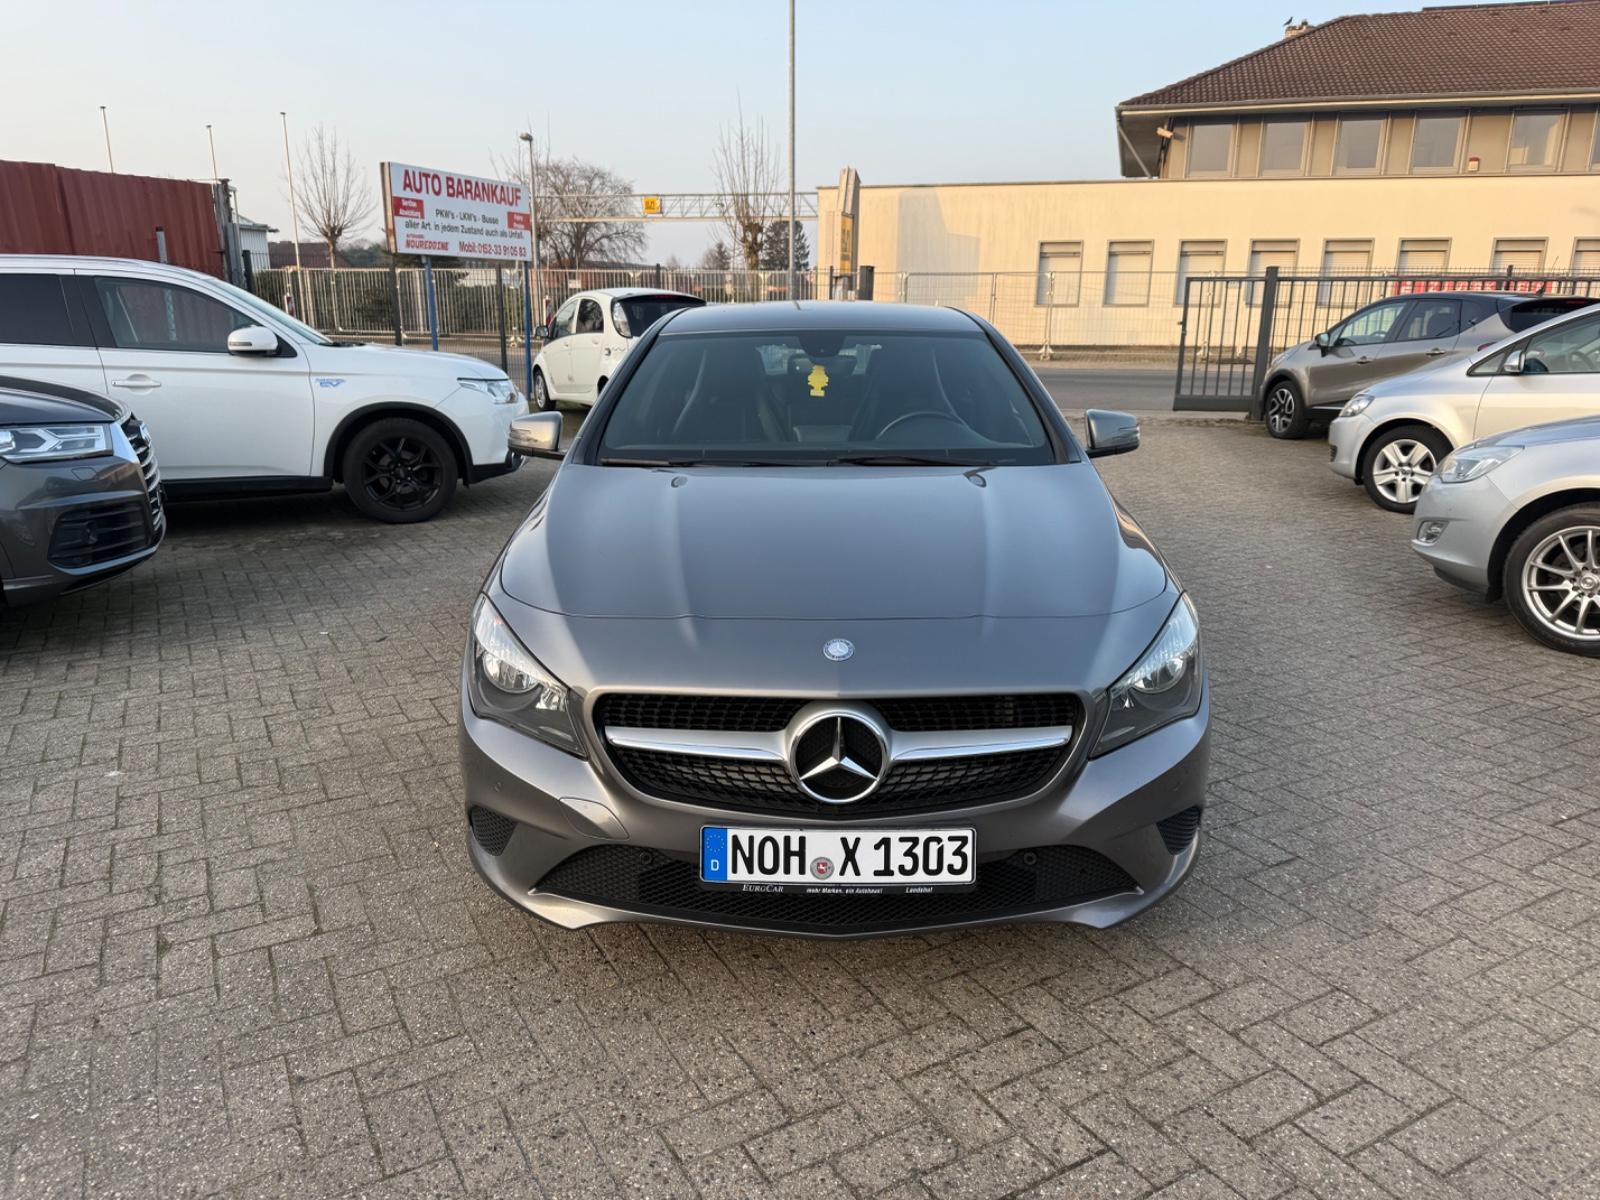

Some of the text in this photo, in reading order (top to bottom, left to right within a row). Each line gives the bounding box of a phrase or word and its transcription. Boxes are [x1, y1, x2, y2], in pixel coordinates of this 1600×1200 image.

[403, 169, 521, 206] AUTO BARANKAUF
[461, 224, 484, 236] Zustand
[731, 834, 969, 876] NOH X 1303
